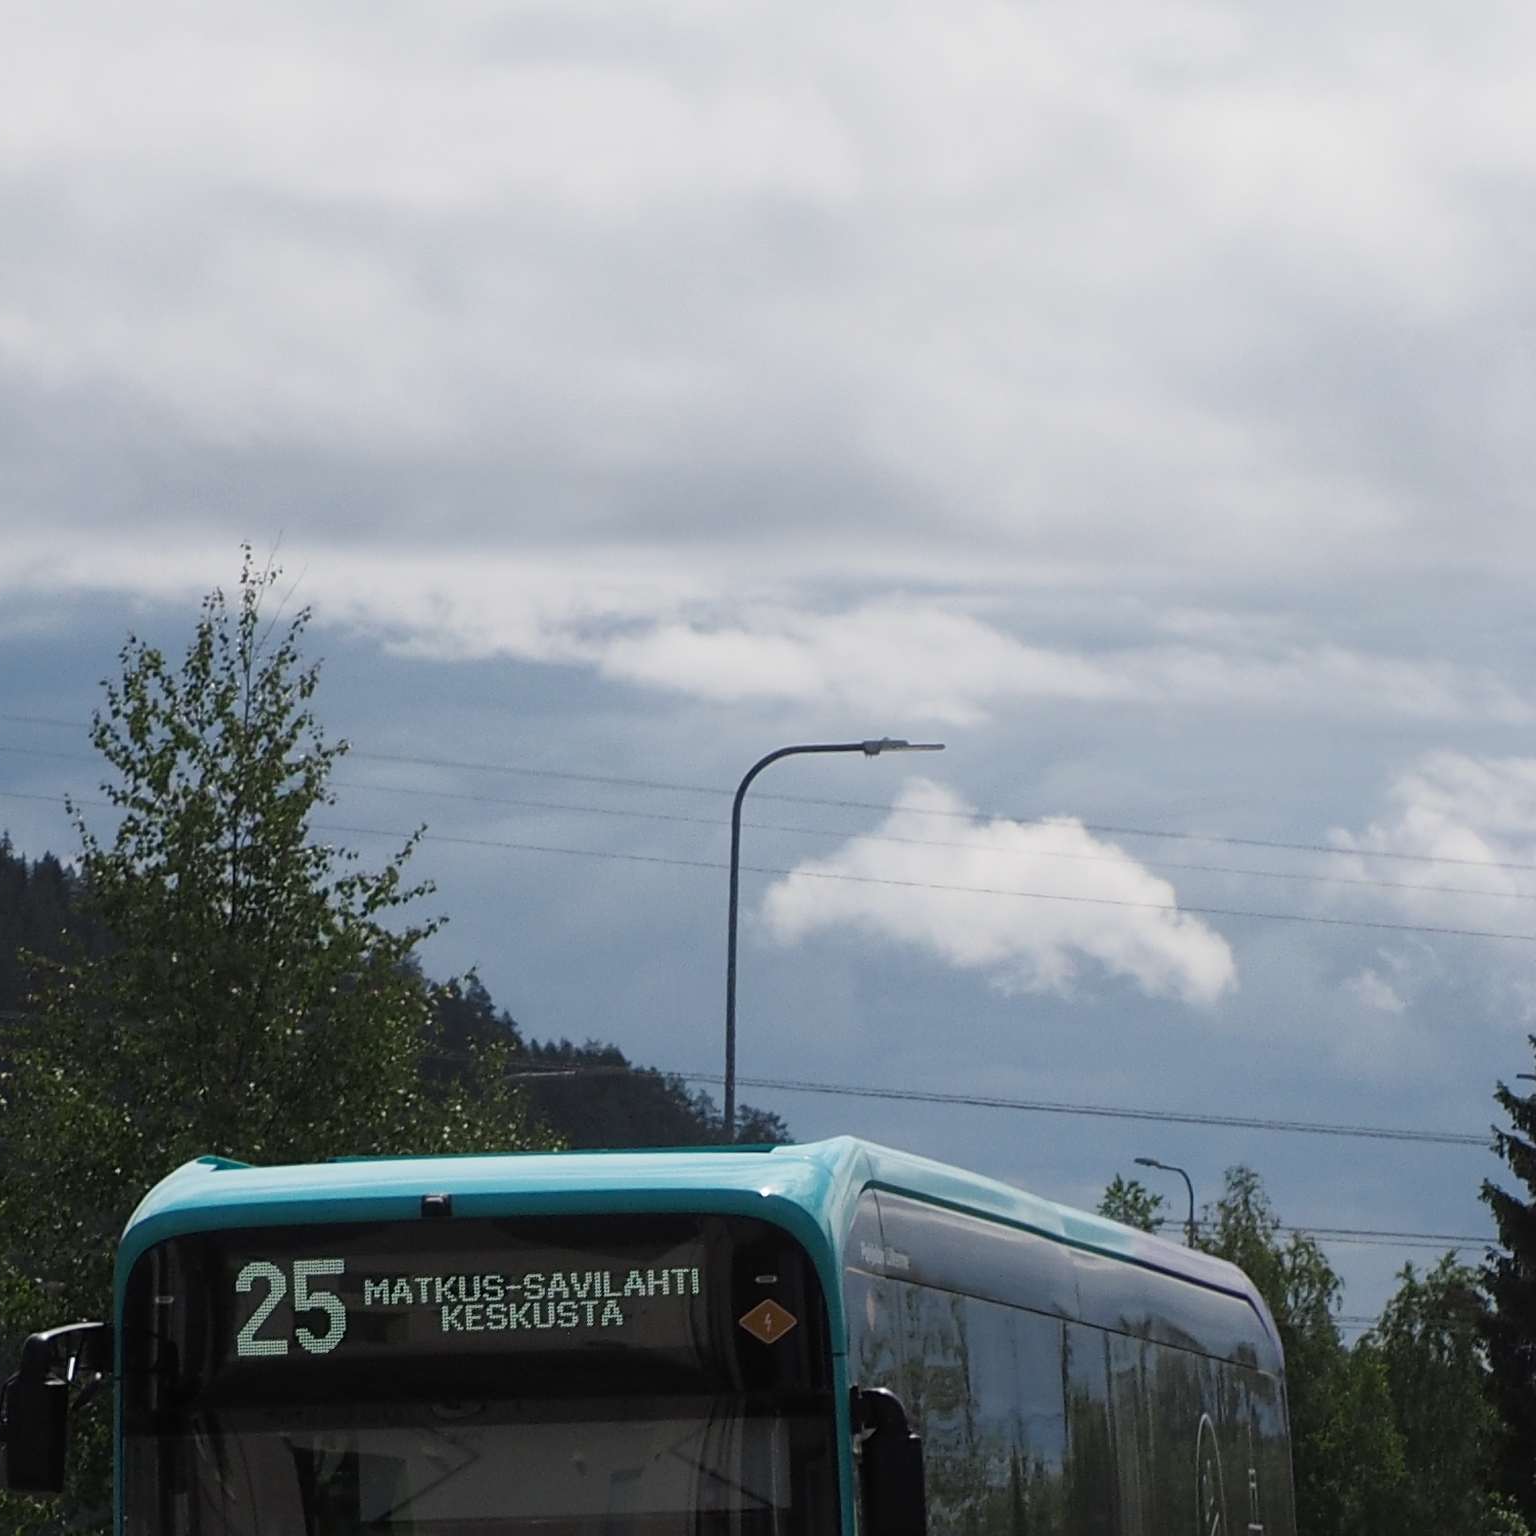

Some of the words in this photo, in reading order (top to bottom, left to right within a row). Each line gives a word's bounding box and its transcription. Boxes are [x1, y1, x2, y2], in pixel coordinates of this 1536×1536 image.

[363, 1268, 701, 1306] MATKUS-SAVILAHTI
[235, 1258, 347, 1357] 25
[440, 1300, 625, 1332] KESKUSTA
